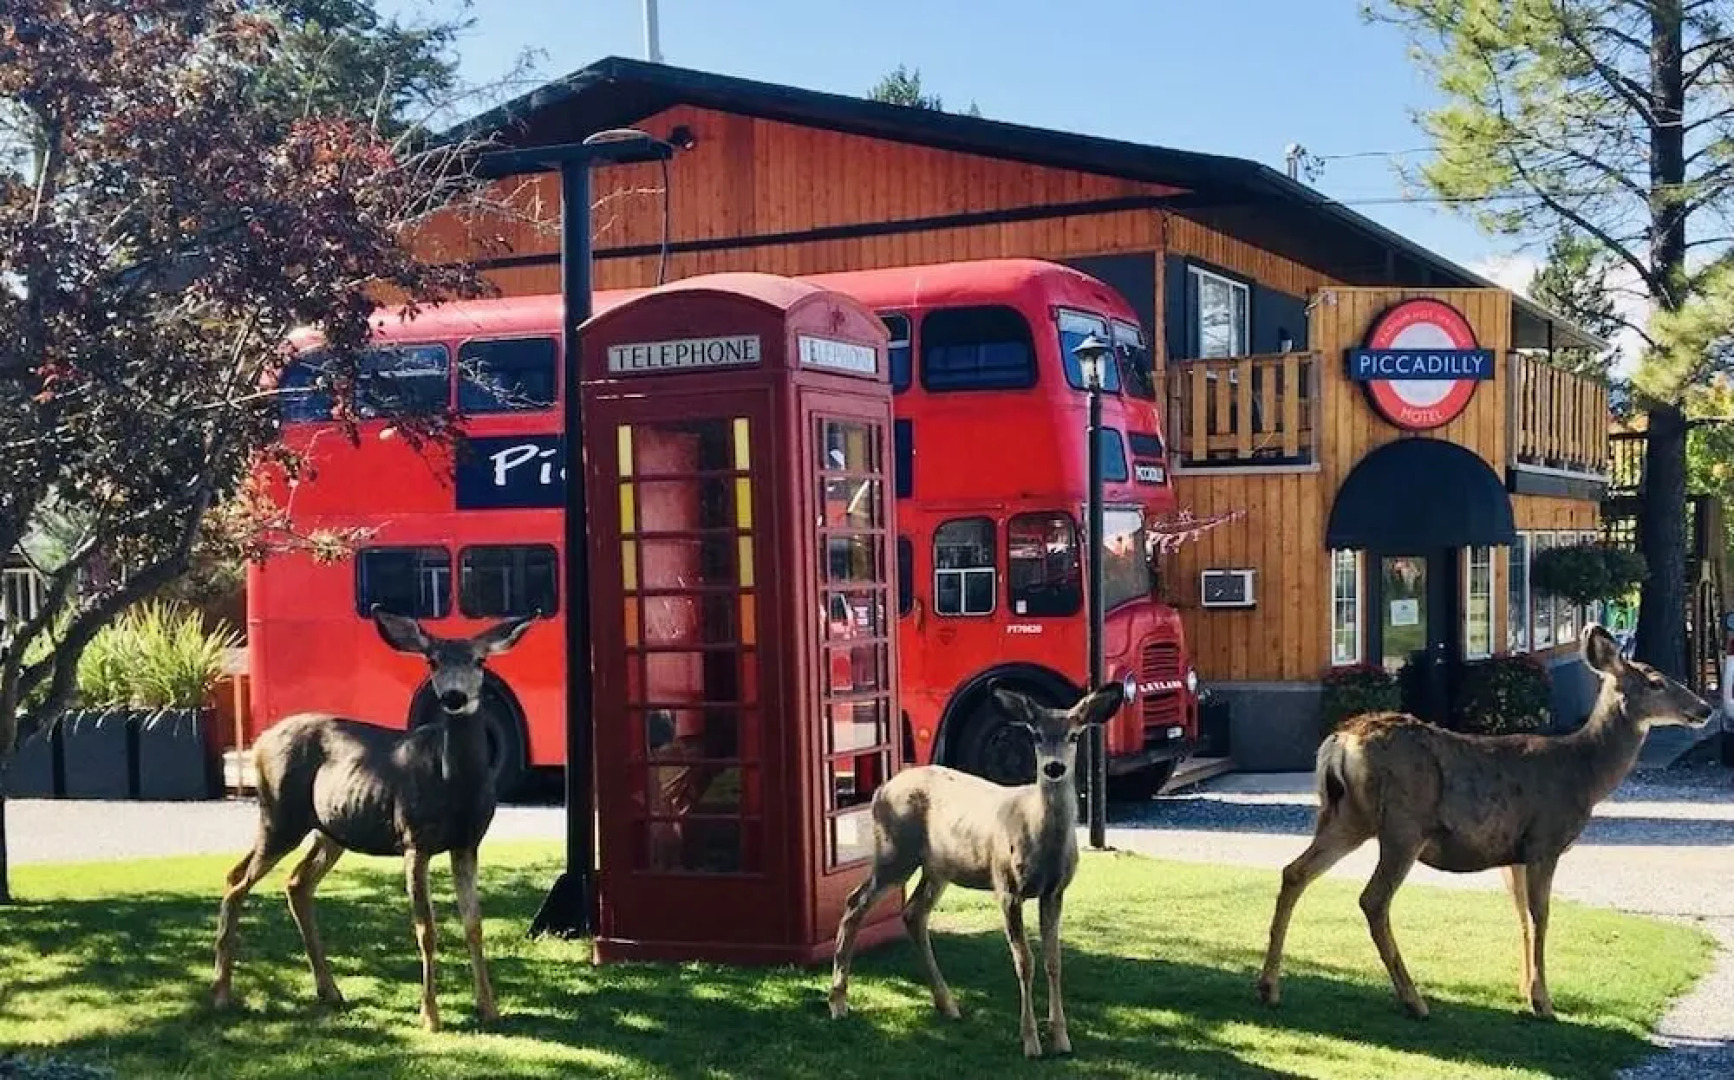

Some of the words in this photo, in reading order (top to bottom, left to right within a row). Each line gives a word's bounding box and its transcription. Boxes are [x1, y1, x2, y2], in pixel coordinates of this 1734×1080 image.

[612, 339, 757, 369] TELEPHONE
[1360, 355, 1483, 373] PICCADILLY
[1401, 408, 1443, 422] MOTEL
[489, 444, 568, 486] Pi
